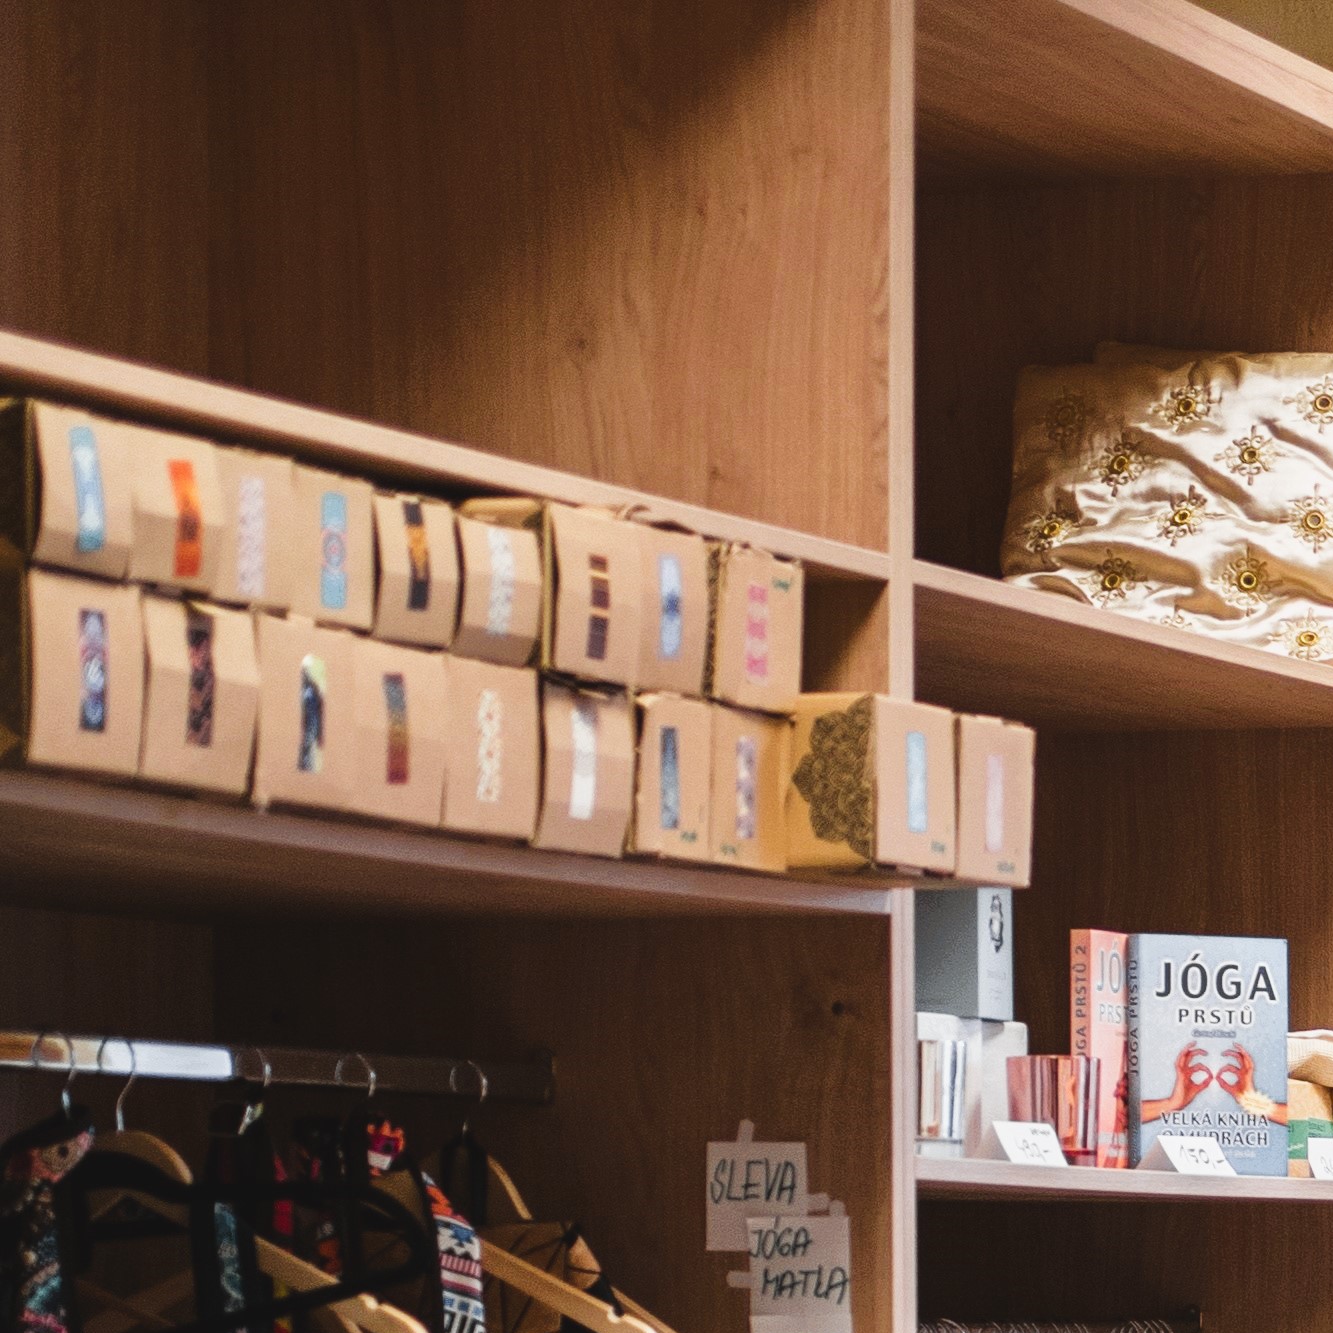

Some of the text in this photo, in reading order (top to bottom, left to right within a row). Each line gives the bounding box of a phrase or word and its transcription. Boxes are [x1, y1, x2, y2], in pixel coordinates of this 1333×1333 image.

[1075, 945, 1086, 955] 2
[1096, 940, 1122, 993] JÓ
[1155, 953, 1277, 1001] JÓGA
[1099, 1003, 1123, 1025] PRS
[1178, 1005, 1253, 1025] PRSTŮ
[1161, 1109, 1269, 1127] VELKÁ KNIHA
[710, 1158, 798, 1204] SLEVA
[750, 1216, 813, 1259] JÓGA
